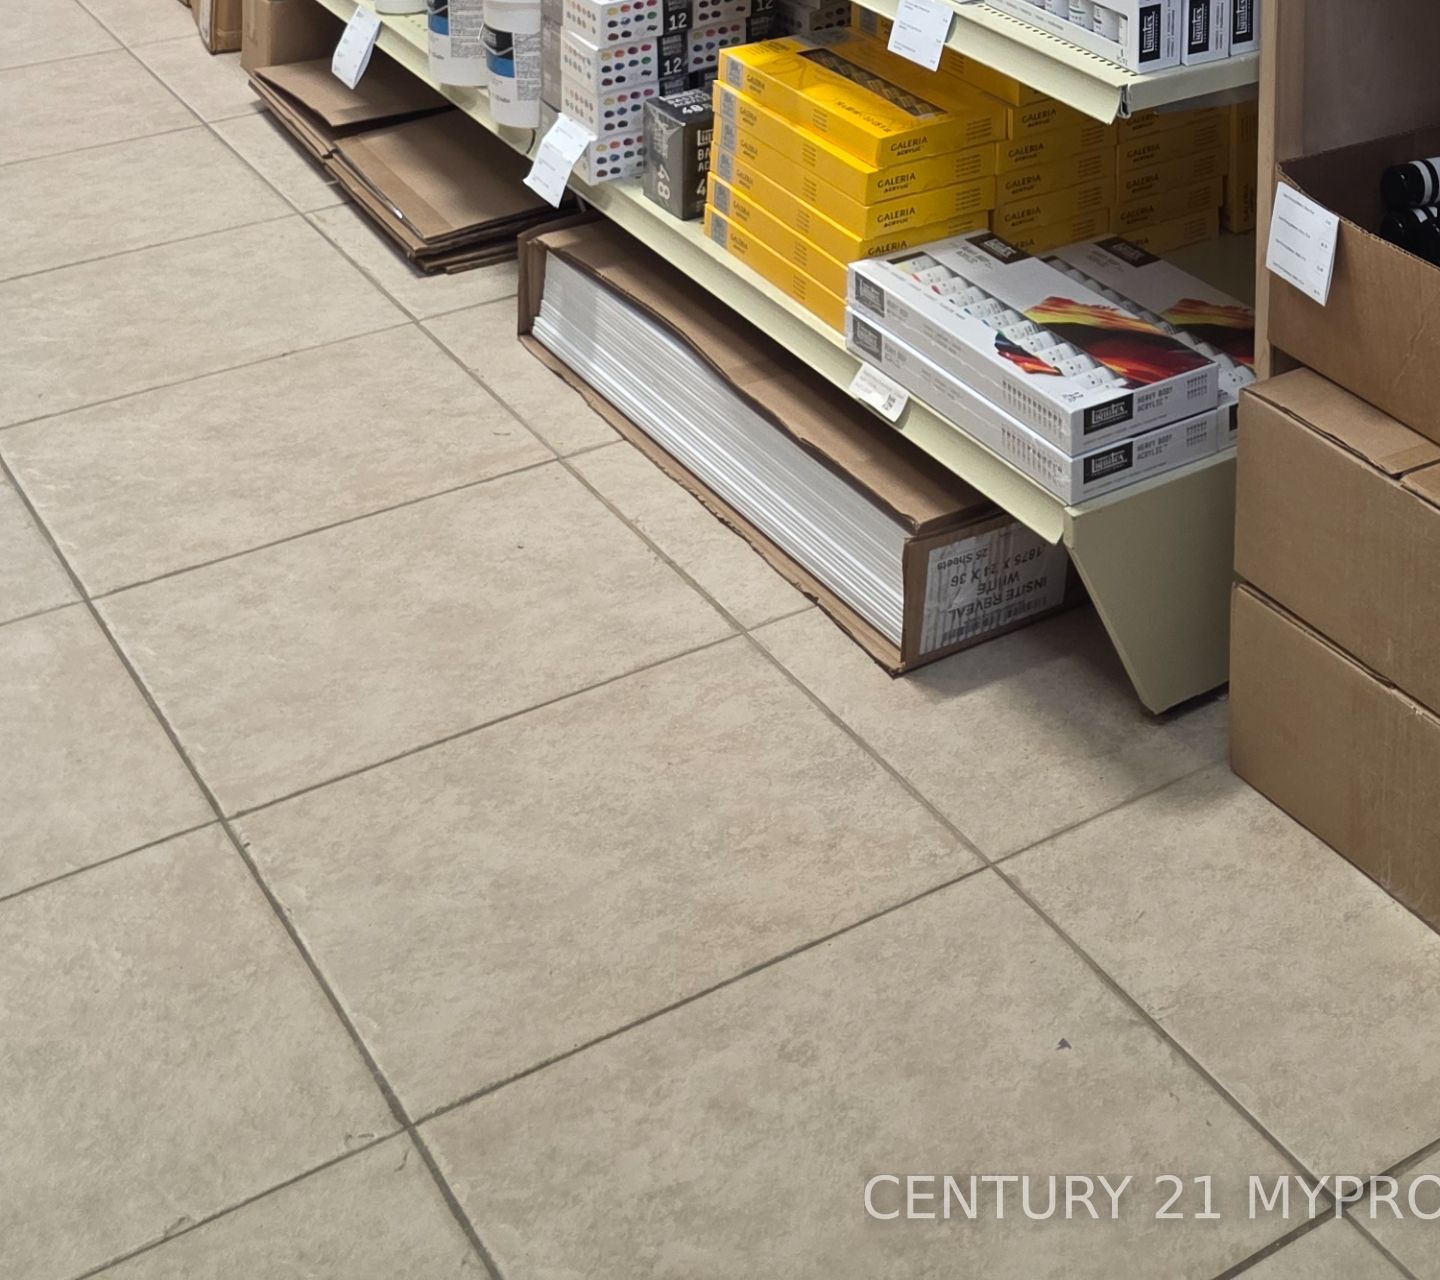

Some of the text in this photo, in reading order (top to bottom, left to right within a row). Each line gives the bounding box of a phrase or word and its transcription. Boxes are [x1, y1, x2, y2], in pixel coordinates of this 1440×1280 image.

[669, 12, 687, 30] 12
[664, 57, 682, 75] 12
[1022, 108, 1057, 123] GALERIA
[890, 136, 928, 152] GALERIA
[1008, 142, 1044, 159] GALERIA
[877, 172, 916, 189] GALERIA
[1005, 174, 1042, 190] GALERIA
[877, 206, 916, 223] GALERIA
[1004, 206, 1041, 223] GALERIA
[868, 240, 907, 256] GALERIA
[937, 552, 973, 570] Sheets
[951, 574, 967, 587] 36
[977, 572, 1020, 596] WHITE
[948, 577, 1047, 621] INSITE REVEAL
